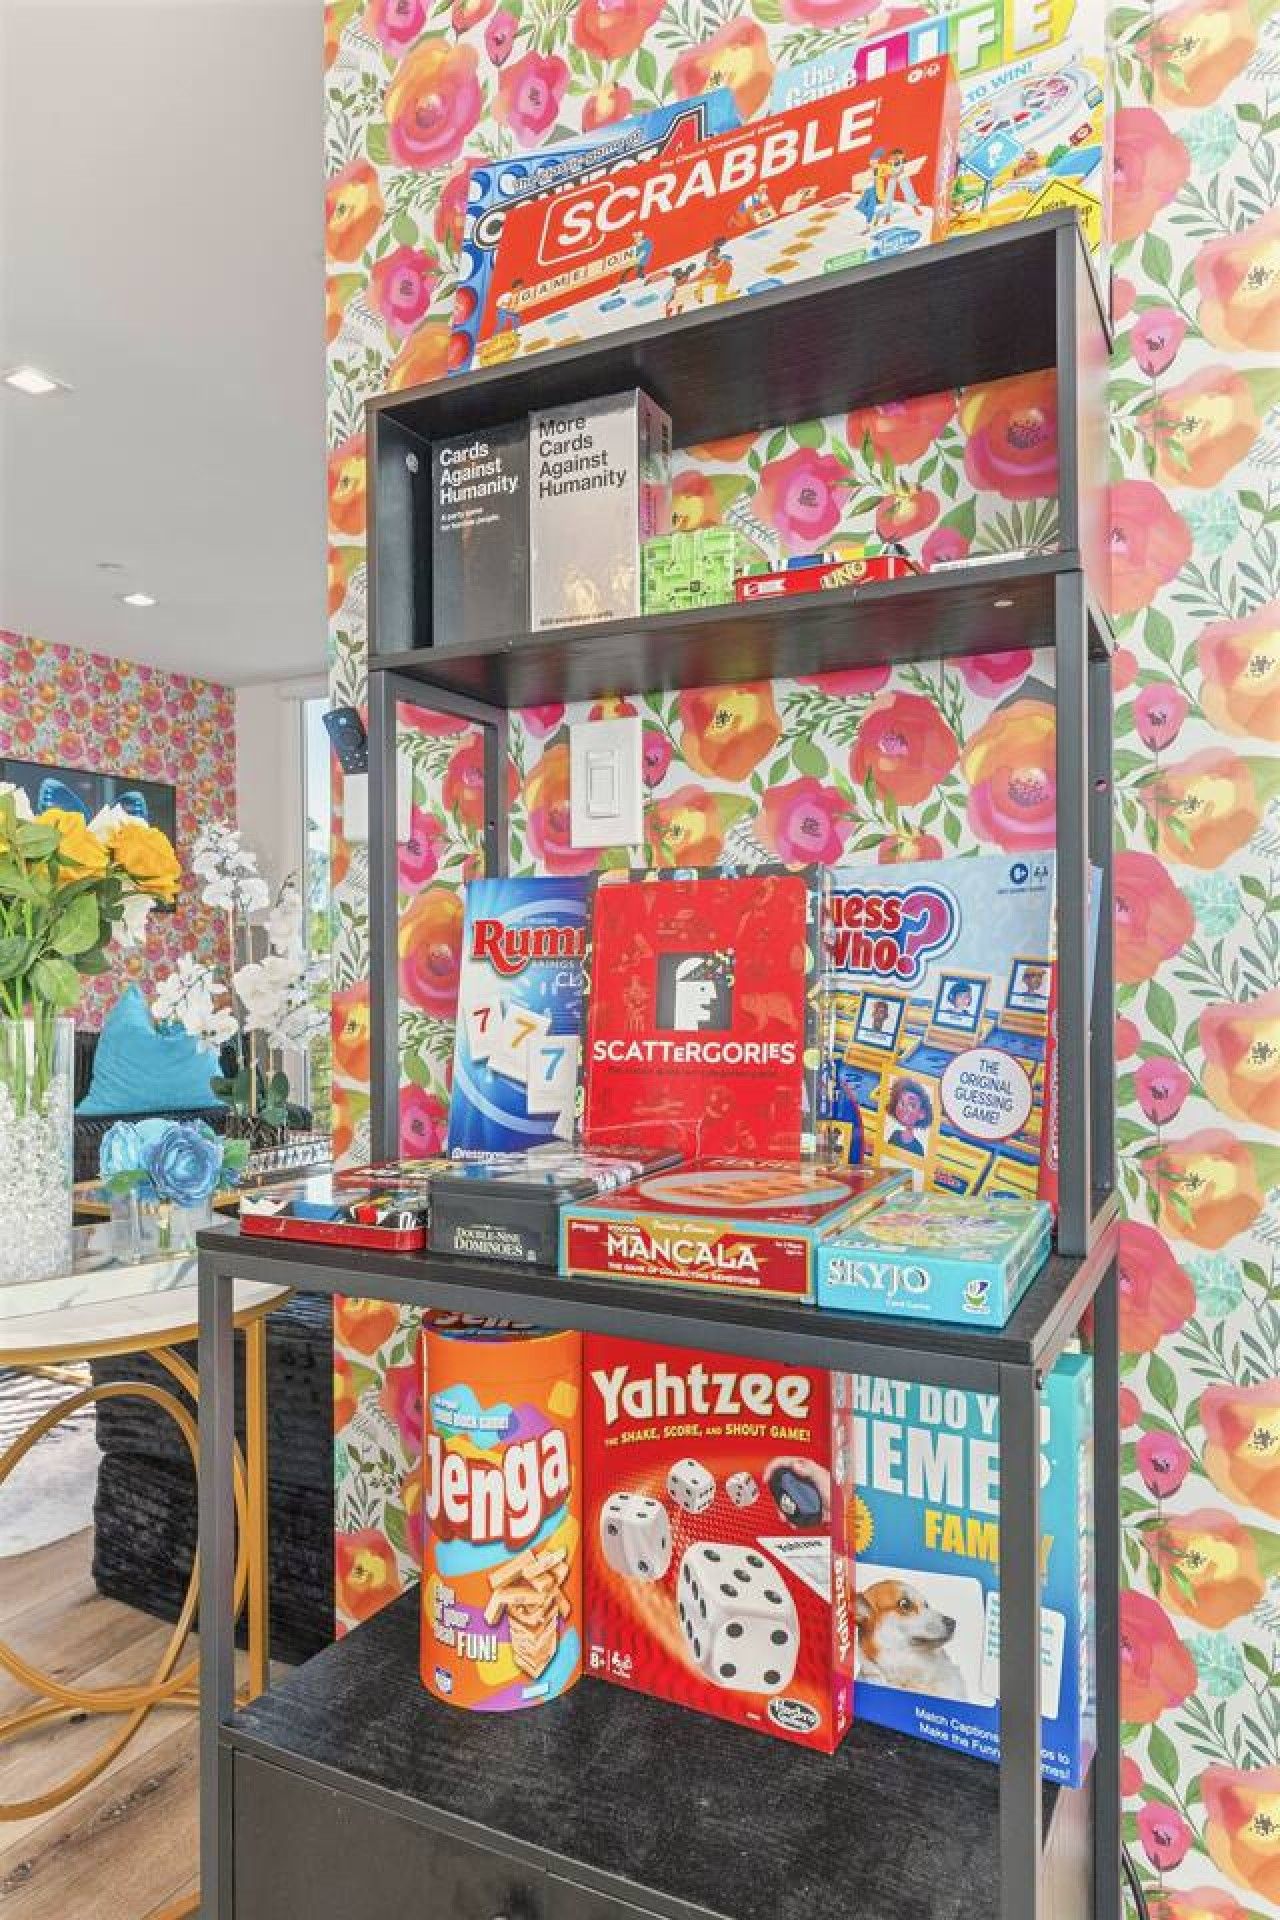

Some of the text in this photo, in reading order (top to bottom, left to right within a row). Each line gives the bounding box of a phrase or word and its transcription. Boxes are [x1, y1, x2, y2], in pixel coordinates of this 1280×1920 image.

[556, 98, 878, 246] SCRABBLE
[539, 416, 587, 439] More
[440, 441, 489, 467] Cards
[539, 433, 593, 459] Cards
[440, 458, 503, 487] Against
[539, 450, 608, 481] Against
[440, 475, 519, 506] Humanity
[539, 469, 627, 499] Humanity
[556, 971, 583, 987] CL
[473, 1008, 491, 1033] 7
[511, 1017, 538, 1048] 7
[540, 1046, 566, 1082] 7
[593, 1039, 796, 1065] SCATTERGORIES
[979, 1058, 1000, 1074] THE
[959, 1072, 1012, 1095] ORIGINAL
[955, 1088, 1014, 1112] GUESSING
[963, 1105, 1001, 1124] GAME!
[454, 1235, 523, 1257] DOMINOES
[606, 1231, 760, 1272] MANCALA
[827, 1257, 930, 1297] SKYJO
[591, 1361, 812, 1426] Yahtzee
[852, 1374, 911, 1419] HAT
[919, 1384, 967, 1429] DO
[620, 1427, 661, 1444] SHAKE,
[663, 1423, 703, 1438] SCORE,
[725, 1423, 767, 1437] SHOUT
[769, 1425, 812, 1443] GAME!
[852, 1416, 1051, 1516] EME
[425, 1427, 569, 1541] Jenga
[457, 1631, 497, 1661] FUN!
[915, 1705, 949, 1727] Match
[1057, 1752, 1071, 1765] to
[919, 1721, 949, 1742] Make
[951, 1733, 969, 1749] the
